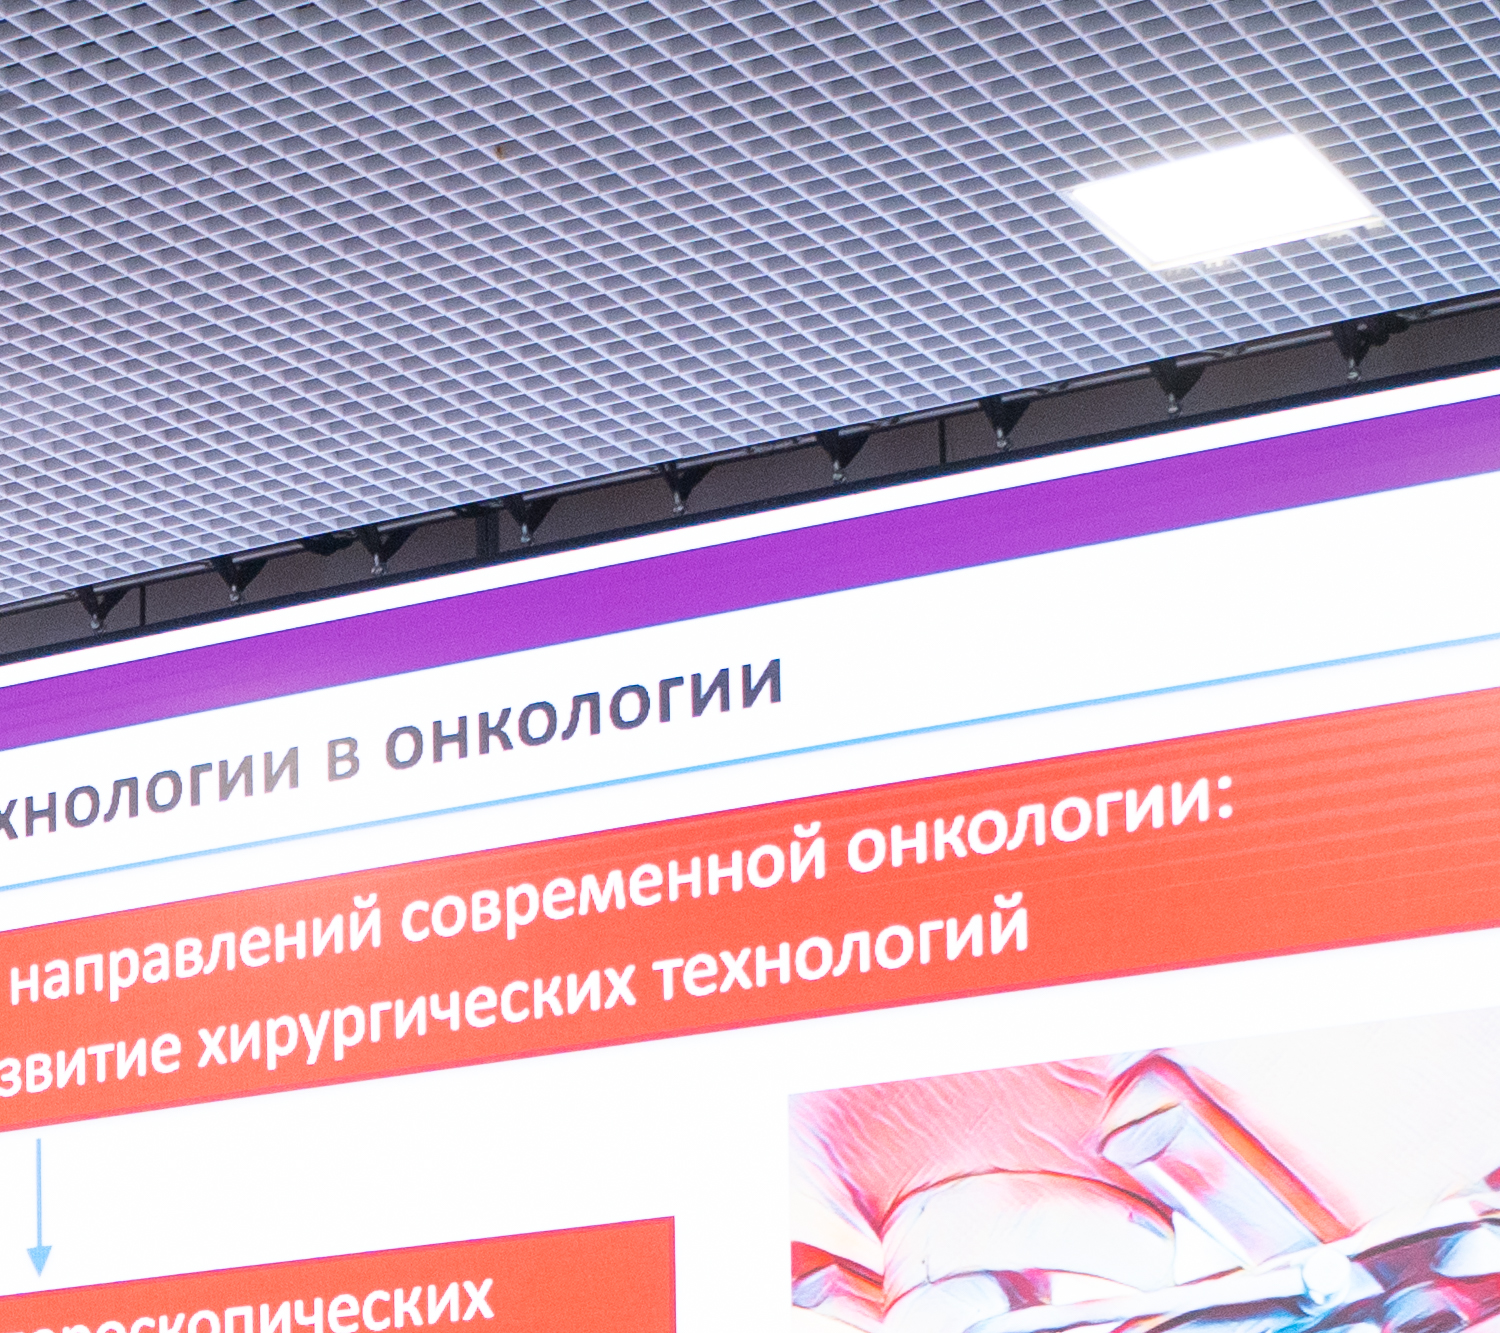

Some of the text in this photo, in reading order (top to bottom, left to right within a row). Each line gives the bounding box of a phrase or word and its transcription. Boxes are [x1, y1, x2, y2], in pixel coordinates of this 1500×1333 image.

[326, 736, 361, 782] в
[385, 658, 781, 770] онкологии
[9, 892, 383, 1003] направлений
[400, 820, 826, 941] современной
[847, 774, 1234, 873] онкологии:
[196, 963, 637, 1071] хирургических
[651, 890, 1029, 1001] технологий
